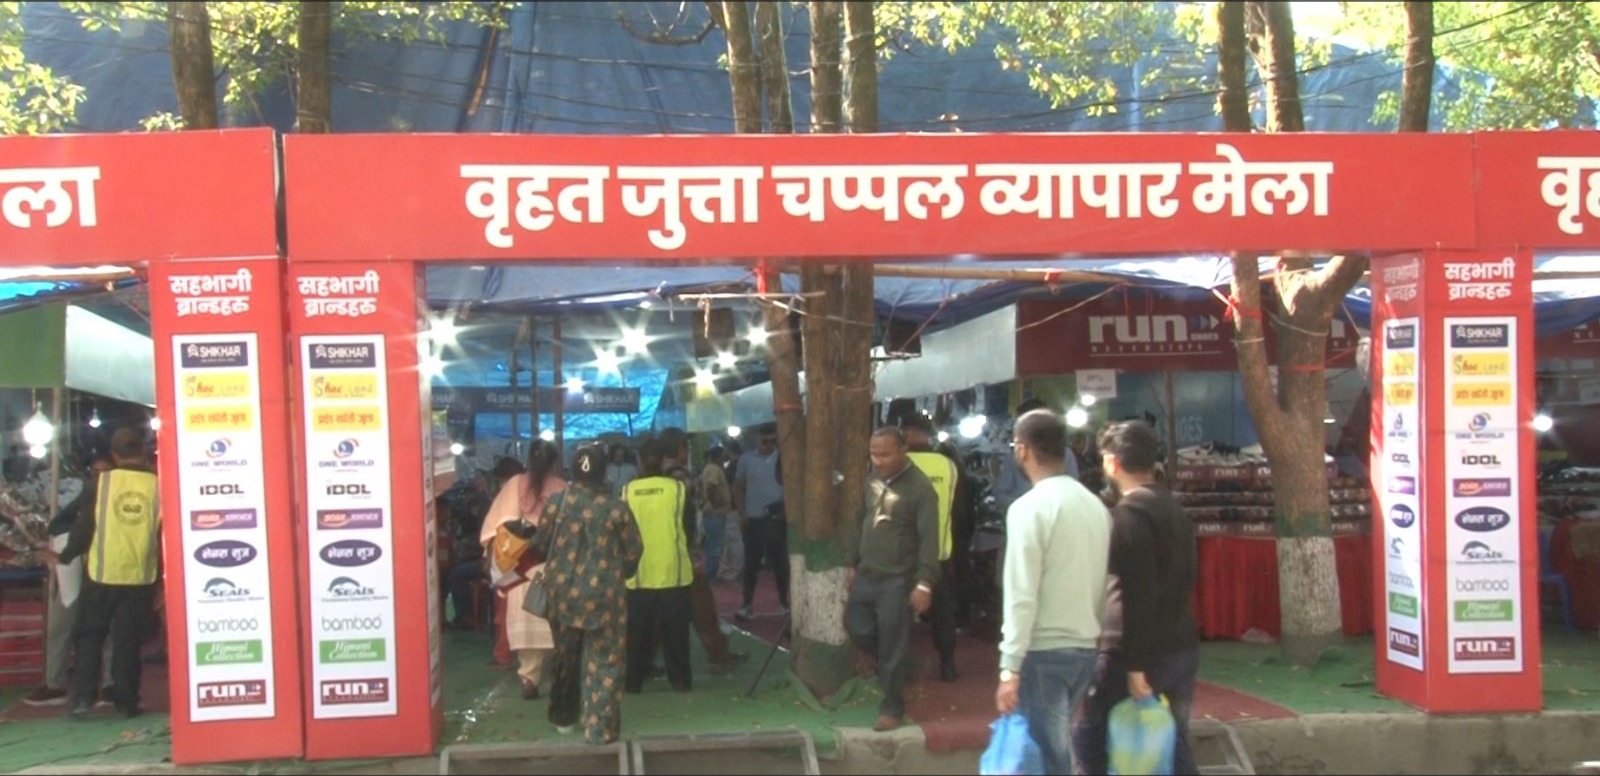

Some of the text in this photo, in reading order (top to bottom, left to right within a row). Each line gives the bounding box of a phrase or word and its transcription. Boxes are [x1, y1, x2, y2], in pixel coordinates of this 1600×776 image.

[0, 166, 100, 228] ला
[460, 143, 1334, 250] वृहत जुत्ता चप्पल व्यापार मेला
[1444, 257, 1515, 281] सहभागी
[168, 268, 253, 295] सहभागी
[297, 270, 380, 296] सहभागी
[1088, 314, 1188, 343] run
[1465, 327, 1502, 338] SHIKHAR
[200, 345, 241, 358] SHIKHAR
[328, 346, 368, 358] SHIKHAR
[191, 459, 247, 468] ONE WORLD
[318, 459, 375, 468] ONE WORLD
[1257, 467, 1271, 476] ru
[634, 487, 664, 497] SECURITY
[1456, 578, 1509, 592] bamboo
[197, 617, 258, 633] bamboo
[322, 616, 382, 632] bamboo
[1456, 640, 1497, 652] run
[199, 683, 246, 699] run
[322, 682, 369, 697] run
